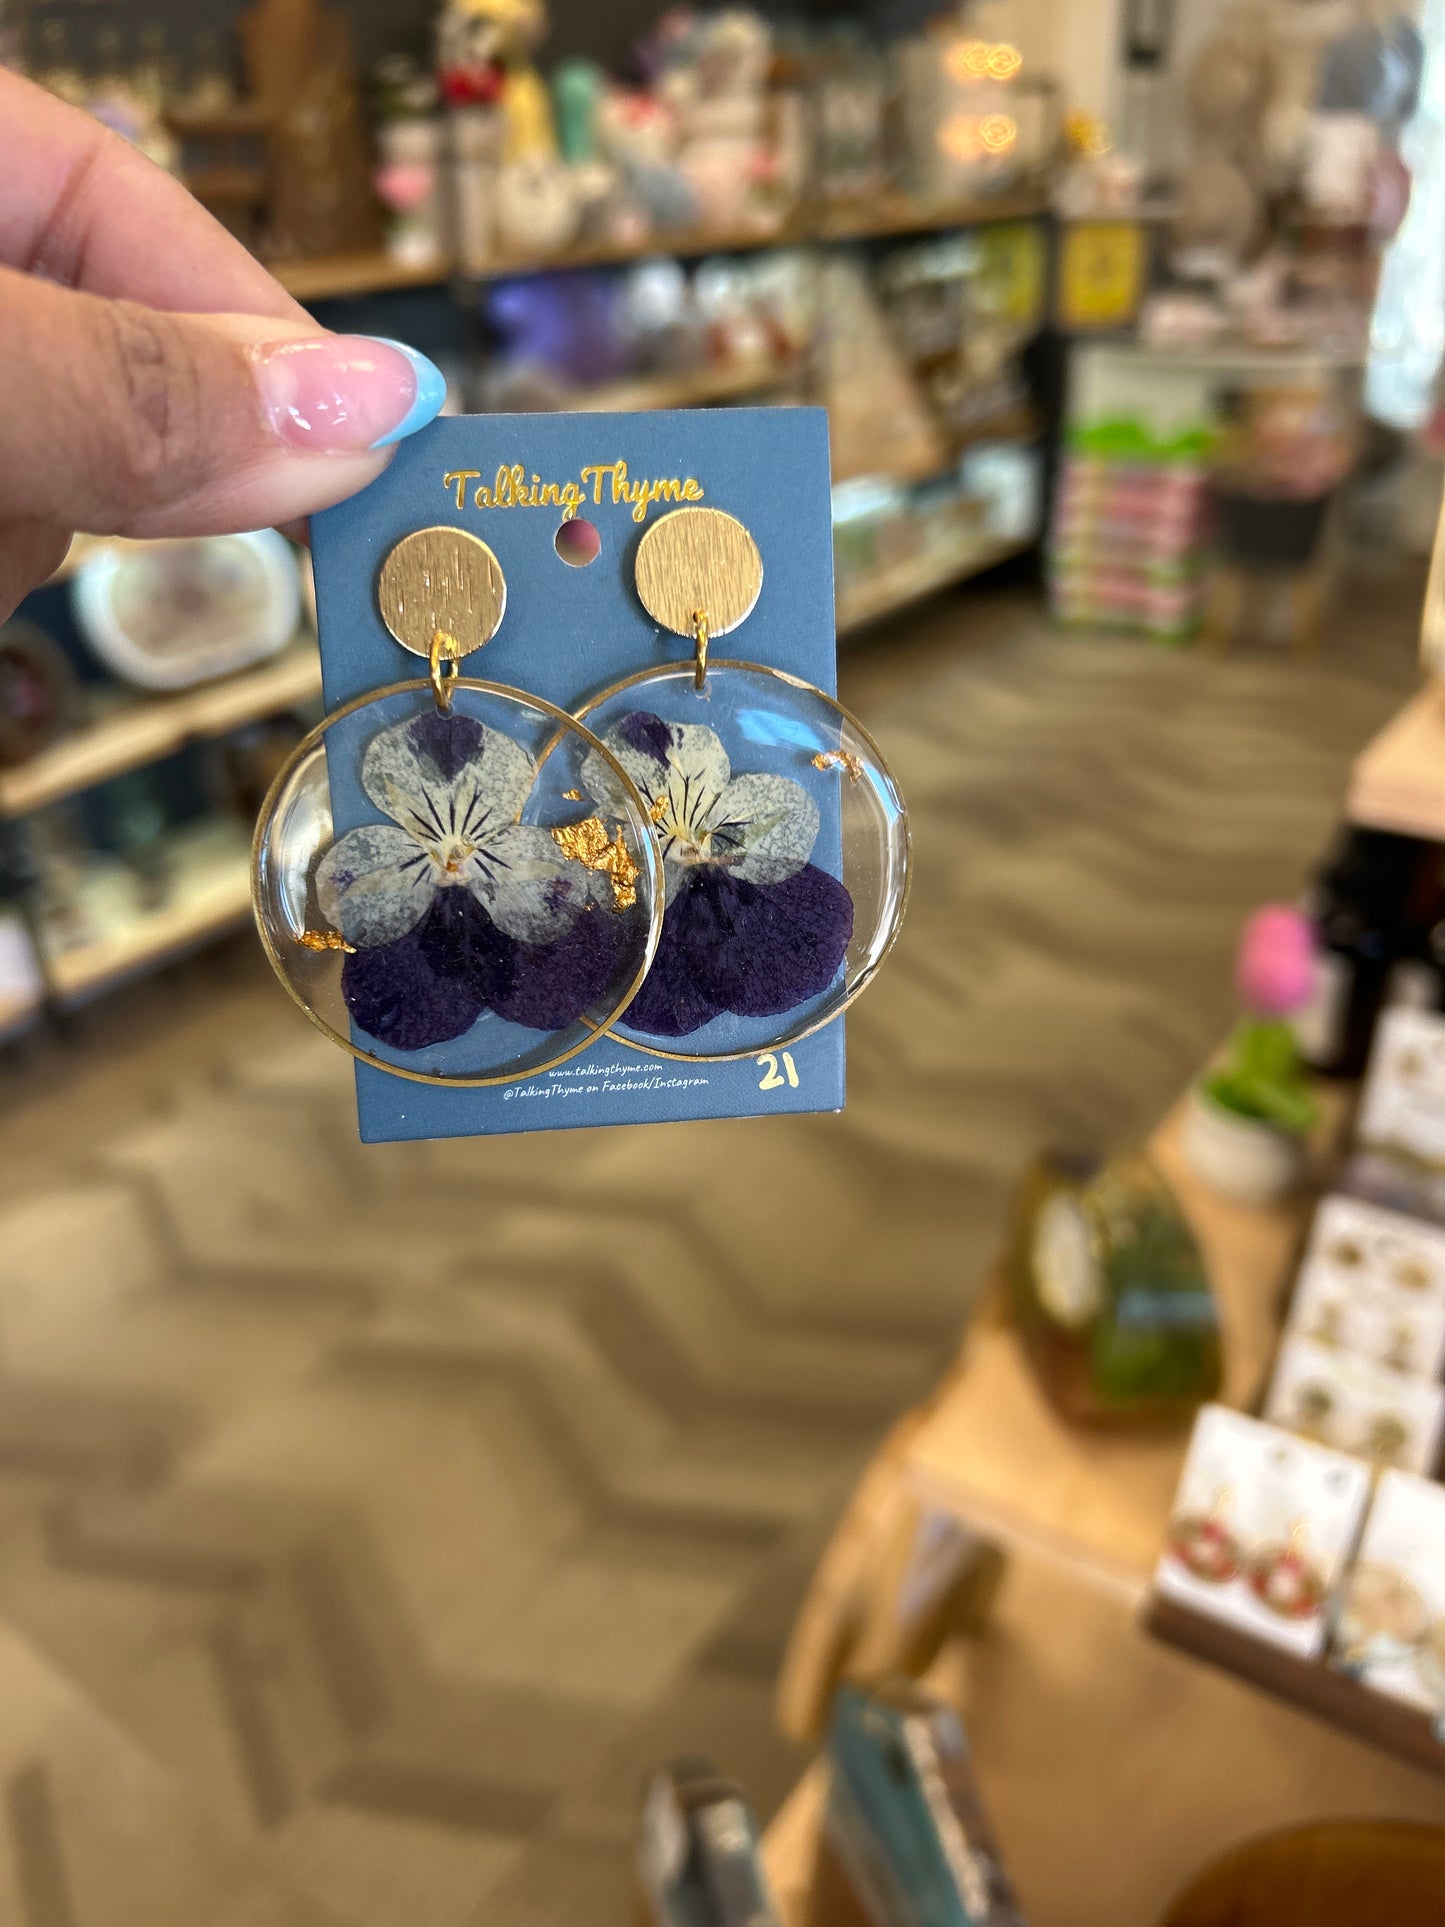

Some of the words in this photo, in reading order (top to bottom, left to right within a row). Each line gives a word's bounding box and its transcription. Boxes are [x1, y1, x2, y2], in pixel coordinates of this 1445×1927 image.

[548, 1062, 663, 1077] www.talkingthyme.com
[756, 1051, 800, 1091] 21
[503, 1084, 584, 1100] @TalkingThyme
[586, 1085, 599, 1093] on
[601, 1077, 709, 1092] Facebook/Instagram
